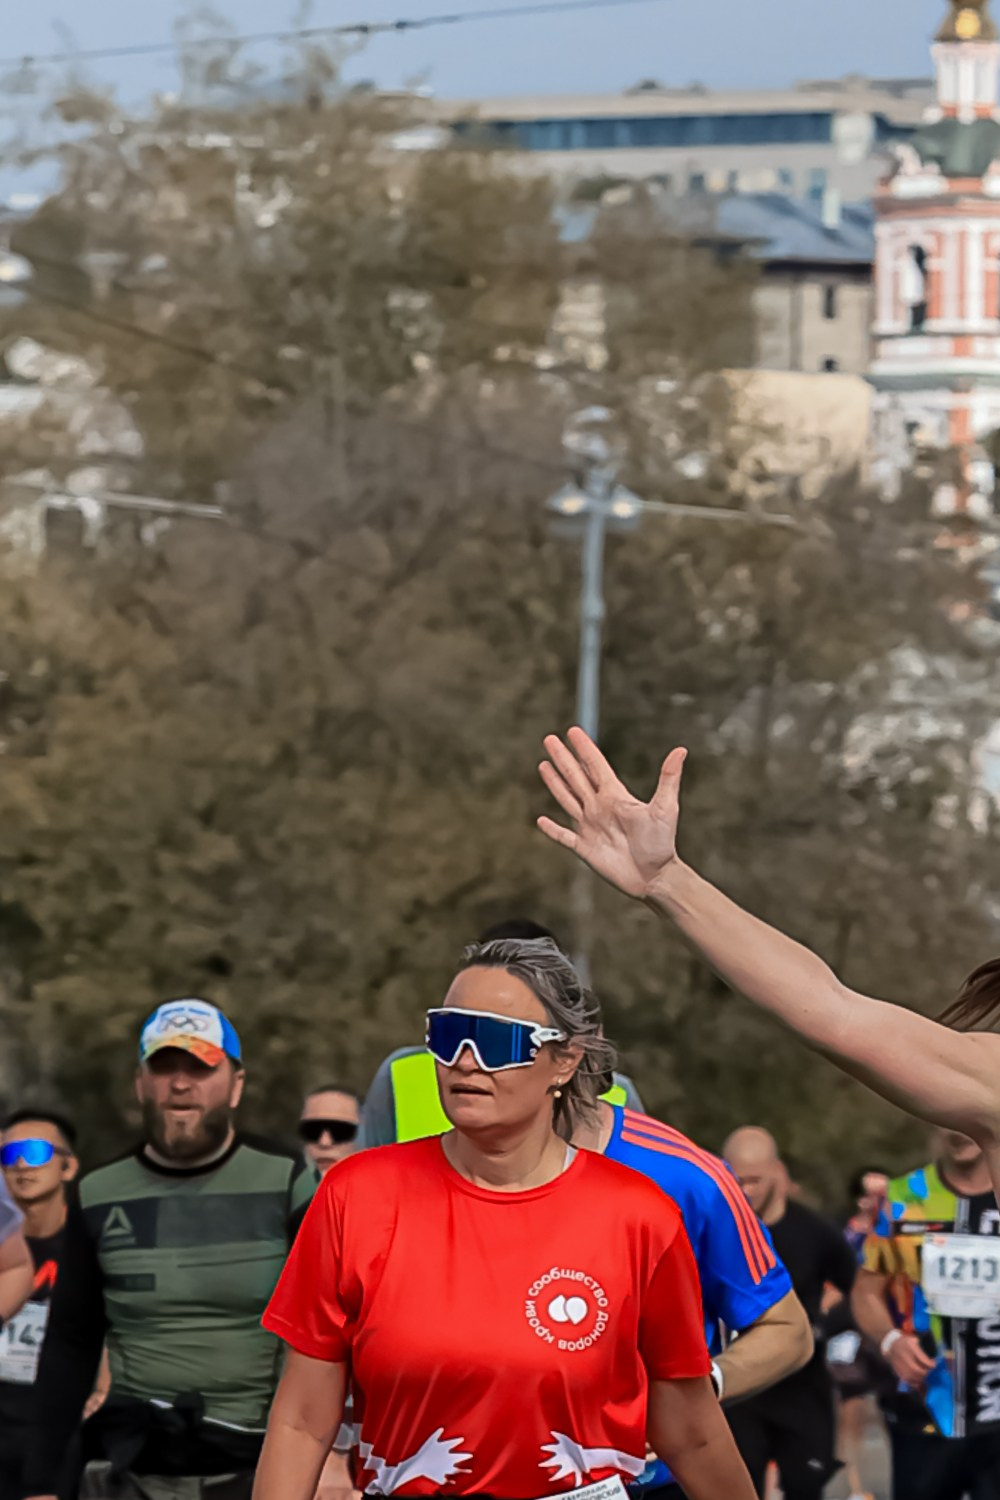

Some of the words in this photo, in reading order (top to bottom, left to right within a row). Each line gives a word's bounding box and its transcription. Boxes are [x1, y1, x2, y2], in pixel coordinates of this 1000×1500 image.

[527, 1266, 609, 1308] сообщество
[524, 1299, 556, 1345] крови
[557, 1310, 609, 1352] доноров
